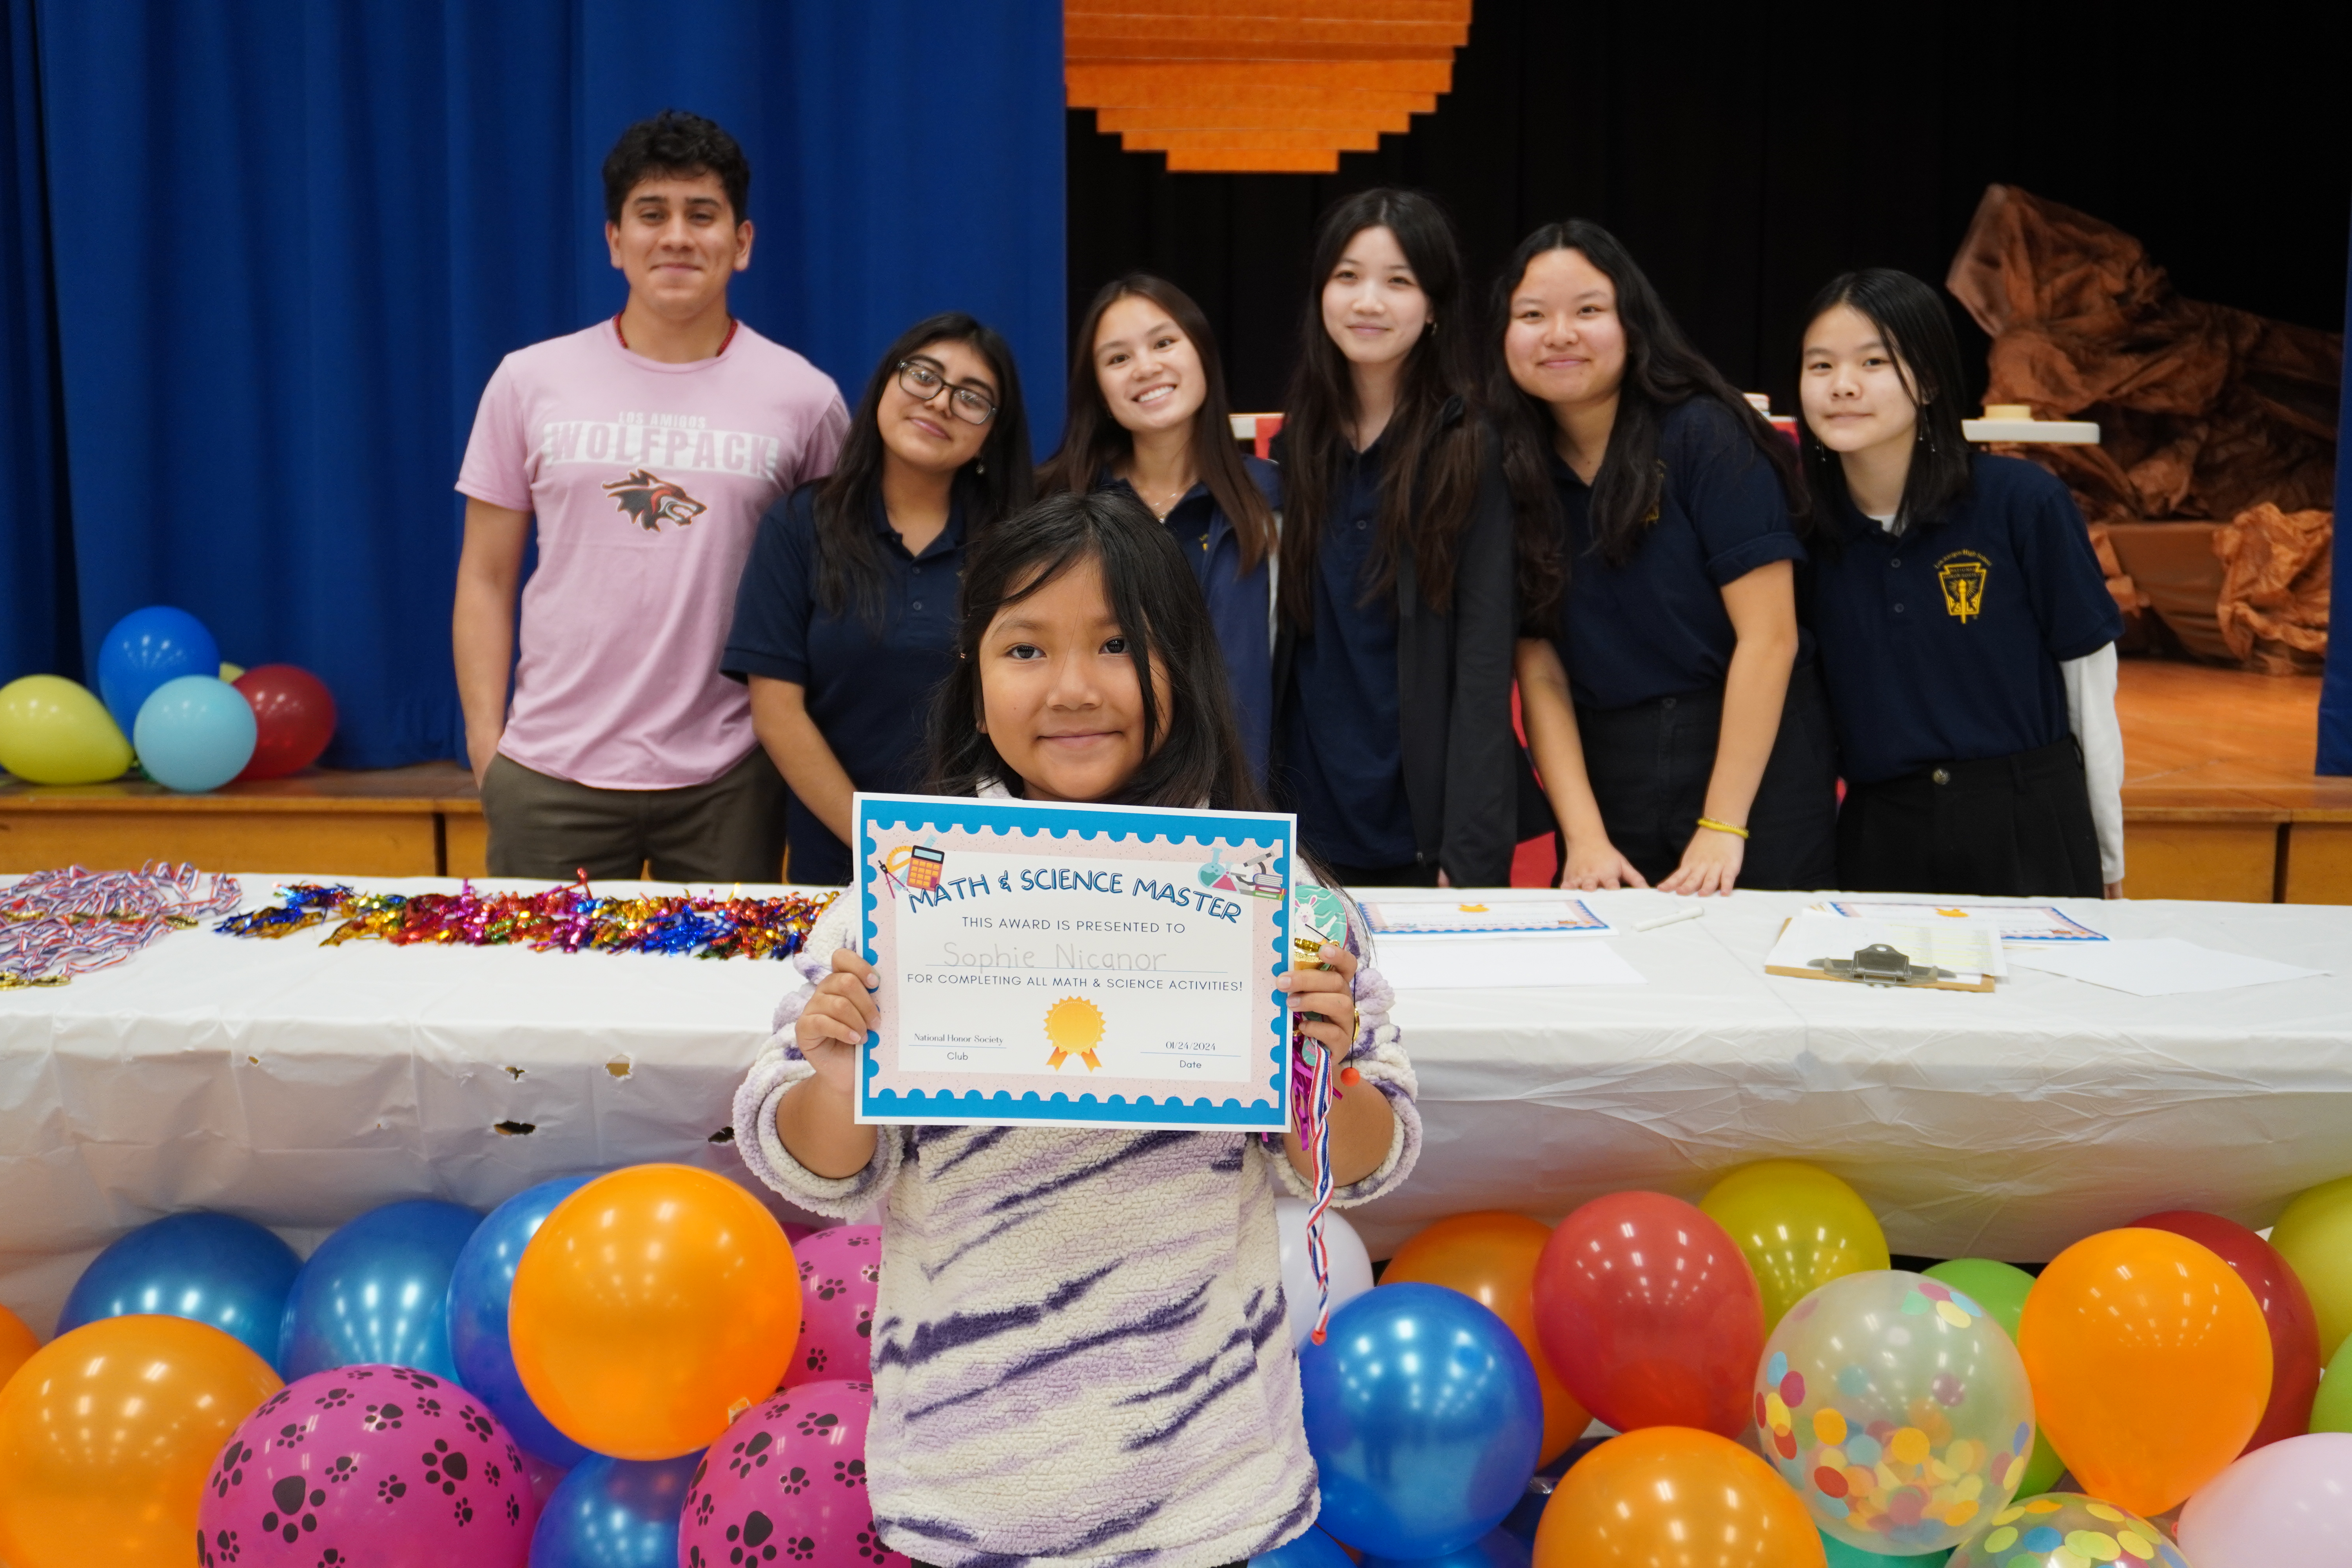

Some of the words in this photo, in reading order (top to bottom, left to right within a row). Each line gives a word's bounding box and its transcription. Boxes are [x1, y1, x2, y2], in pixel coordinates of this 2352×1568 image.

[618, 412, 643, 425] LOS
[650, 413, 706, 429] AMIGOS
[549, 422, 772, 474] WOLFPACK
[909, 875, 990, 913] MATH
[998, 870, 1011, 892] &
[1020, 869, 1123, 893] SCIENCE
[1132, 878, 1241, 924] MASTER
[962, 917, 993, 928] THIS
[999, 918, 1050, 929] AWARD
[1057, 920, 1070, 930] IS
[1077, 921, 1159, 933] PRESENTED
[1166, 923, 1185, 933] TO
[944, 942, 1034, 974] Sophie
[1056, 943, 1167, 971] Nicanor
[907, 974, 933, 983] FOR
[938, 975, 1021, 985] COMPLETING
[1027, 977, 1047, 986] ALL
[1052, 978, 1087, 987] MATH
[1093, 978, 1101, 987] &
[1107, 979, 1163, 989] SCIENCE
[1169, 981, 1243, 991] ACTIVITIES!
[914, 1033, 945, 1042] National
[974, 1035, 1004, 1046] Society
[1166, 1041, 1216, 1051] 01/24/2024
[947, 1052, 968, 1060] Club
[1180, 1060, 1201, 1068] Date
